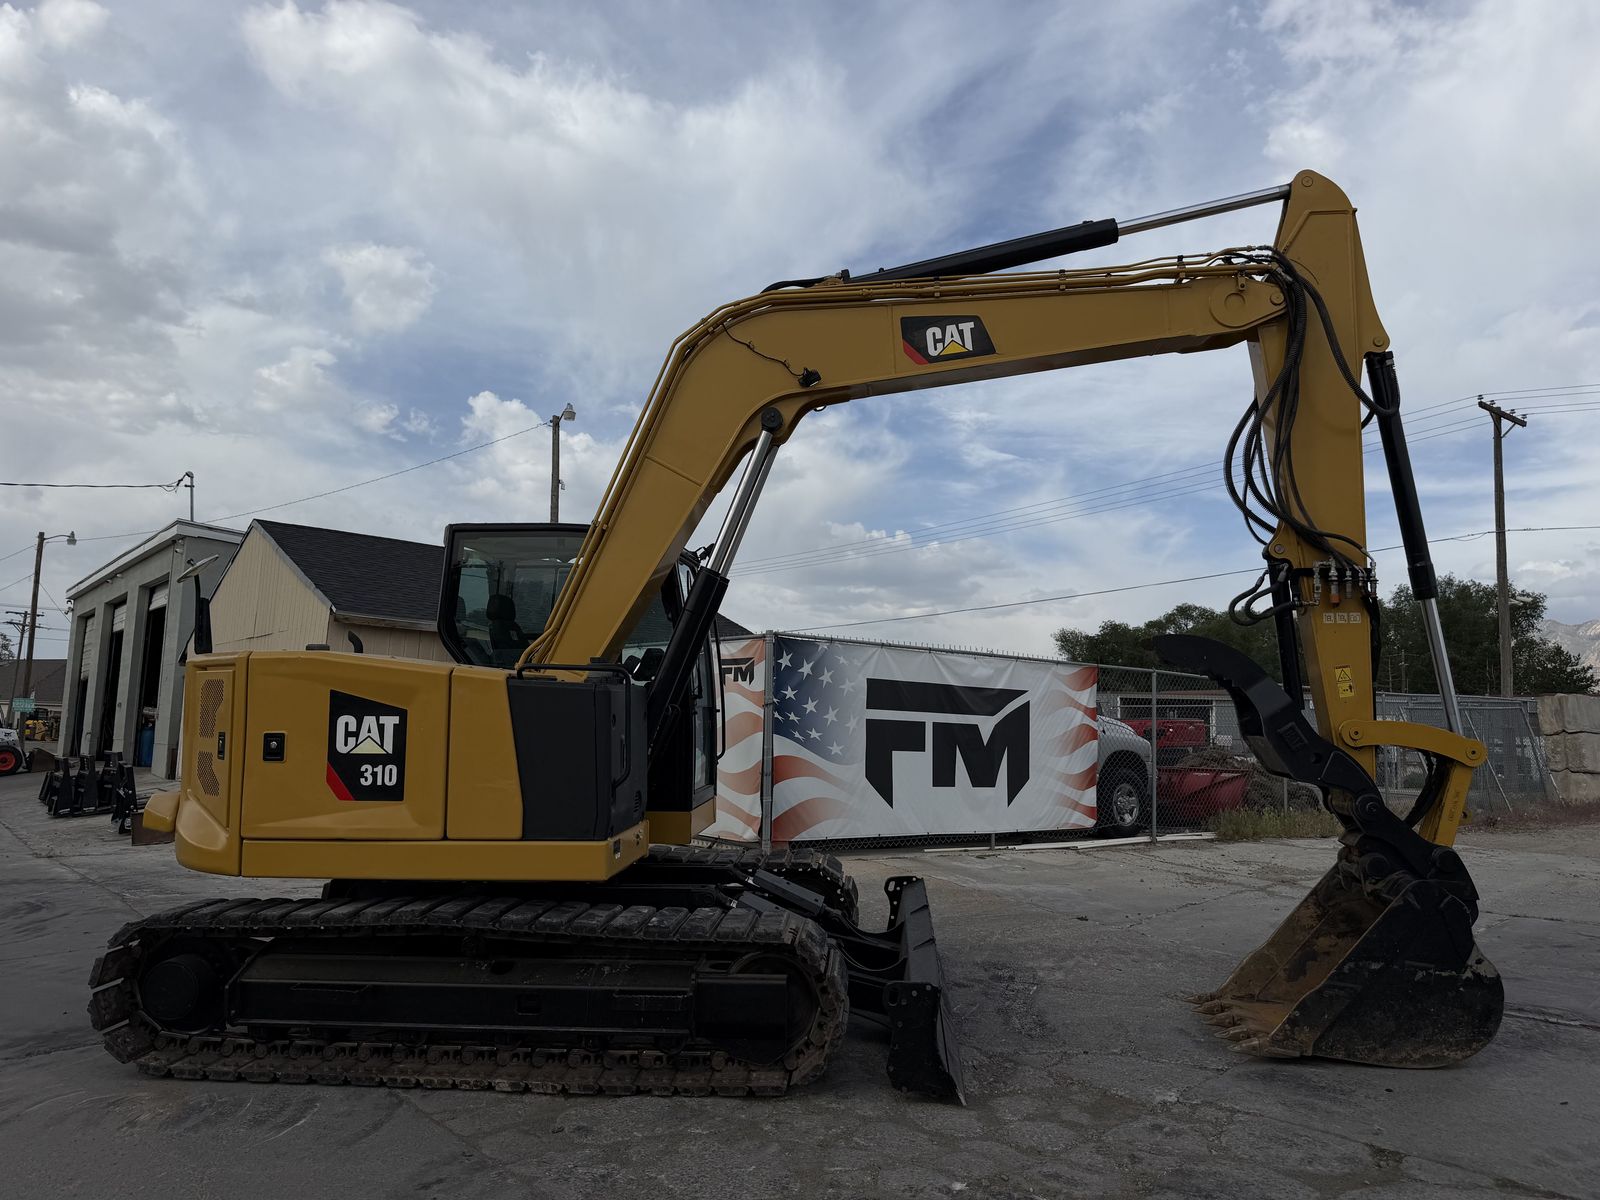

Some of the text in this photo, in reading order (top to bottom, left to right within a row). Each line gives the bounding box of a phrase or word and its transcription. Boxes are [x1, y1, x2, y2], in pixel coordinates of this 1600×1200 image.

[926, 322, 975, 357] CAT
[721, 657, 755, 686] FM
[335, 714, 400, 755] CAT
[865, 678, 1030, 809] FM
[360, 764, 398, 786] 310
